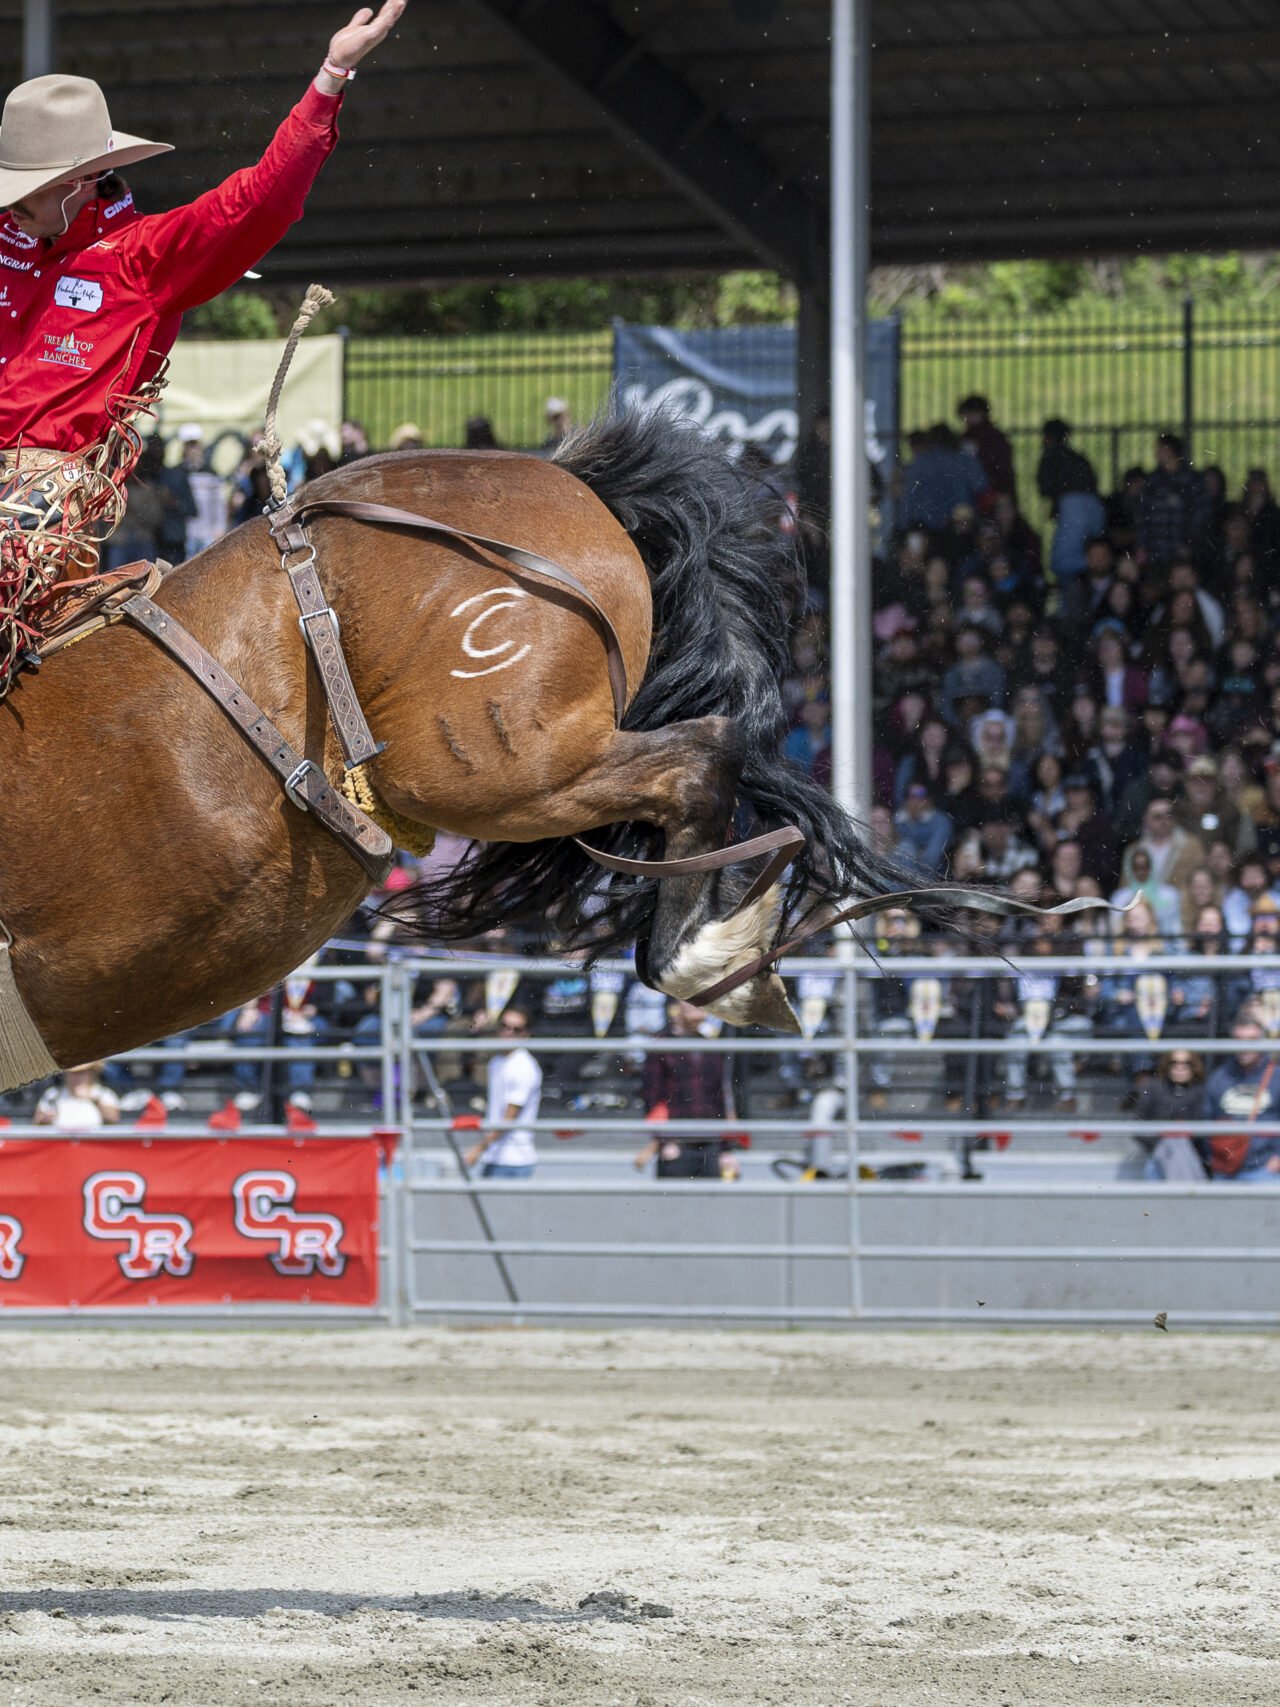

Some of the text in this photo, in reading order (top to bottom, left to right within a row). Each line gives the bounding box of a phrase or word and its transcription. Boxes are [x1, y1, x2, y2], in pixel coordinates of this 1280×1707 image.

[43, 334, 94, 352] TREE TOP
[43, 350, 87, 367] RANCHES
[83, 1171, 195, 1278] CR
[232, 1170, 347, 1276] CR
